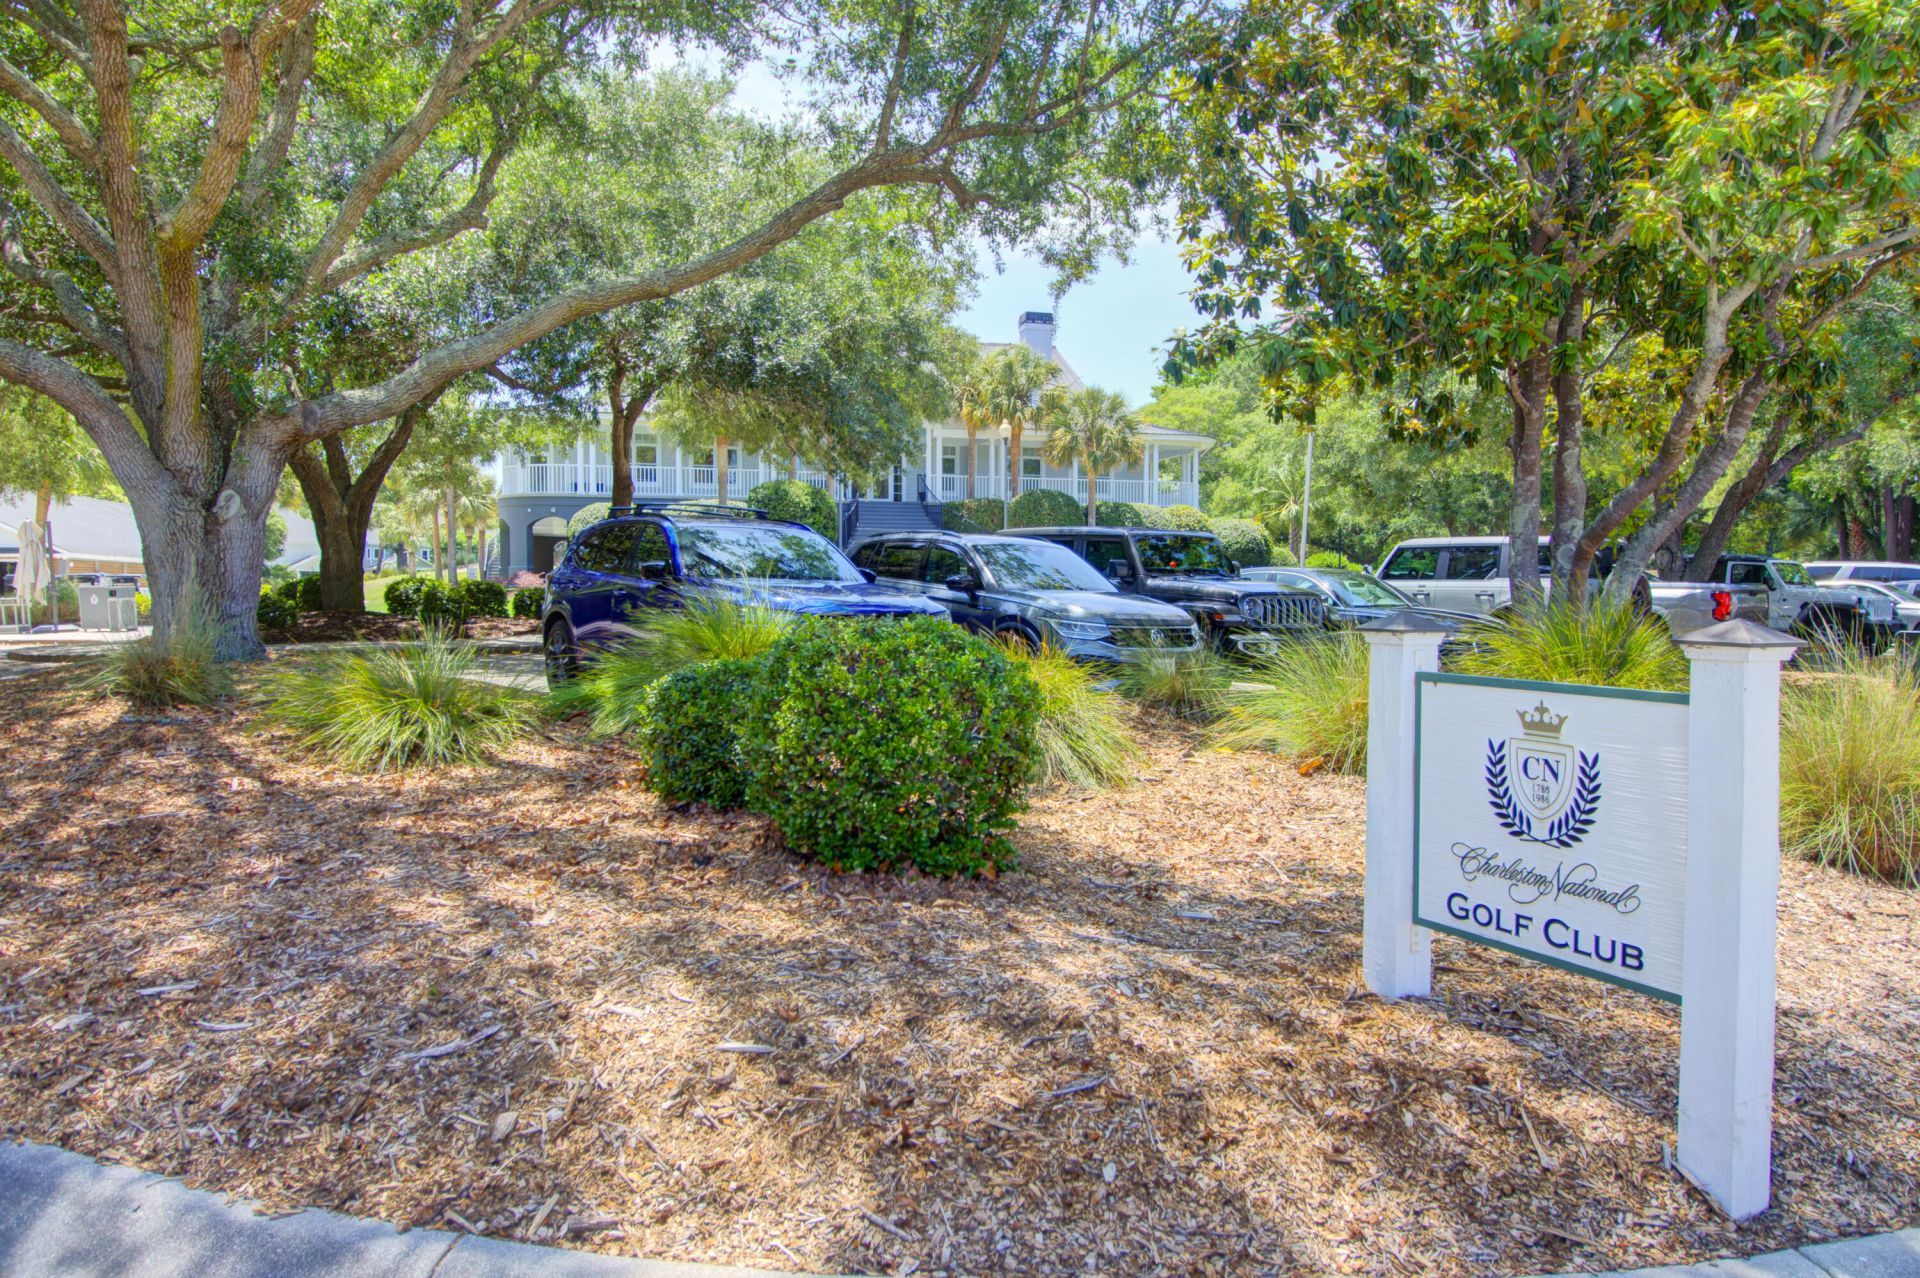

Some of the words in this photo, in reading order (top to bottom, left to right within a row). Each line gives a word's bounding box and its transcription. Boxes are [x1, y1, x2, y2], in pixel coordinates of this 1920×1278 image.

[1522, 756, 1561, 784] CN
[1532, 792, 1550, 804] 1986
[1451, 842, 1553, 897] Charleston
[1542, 861, 1641, 914] National
